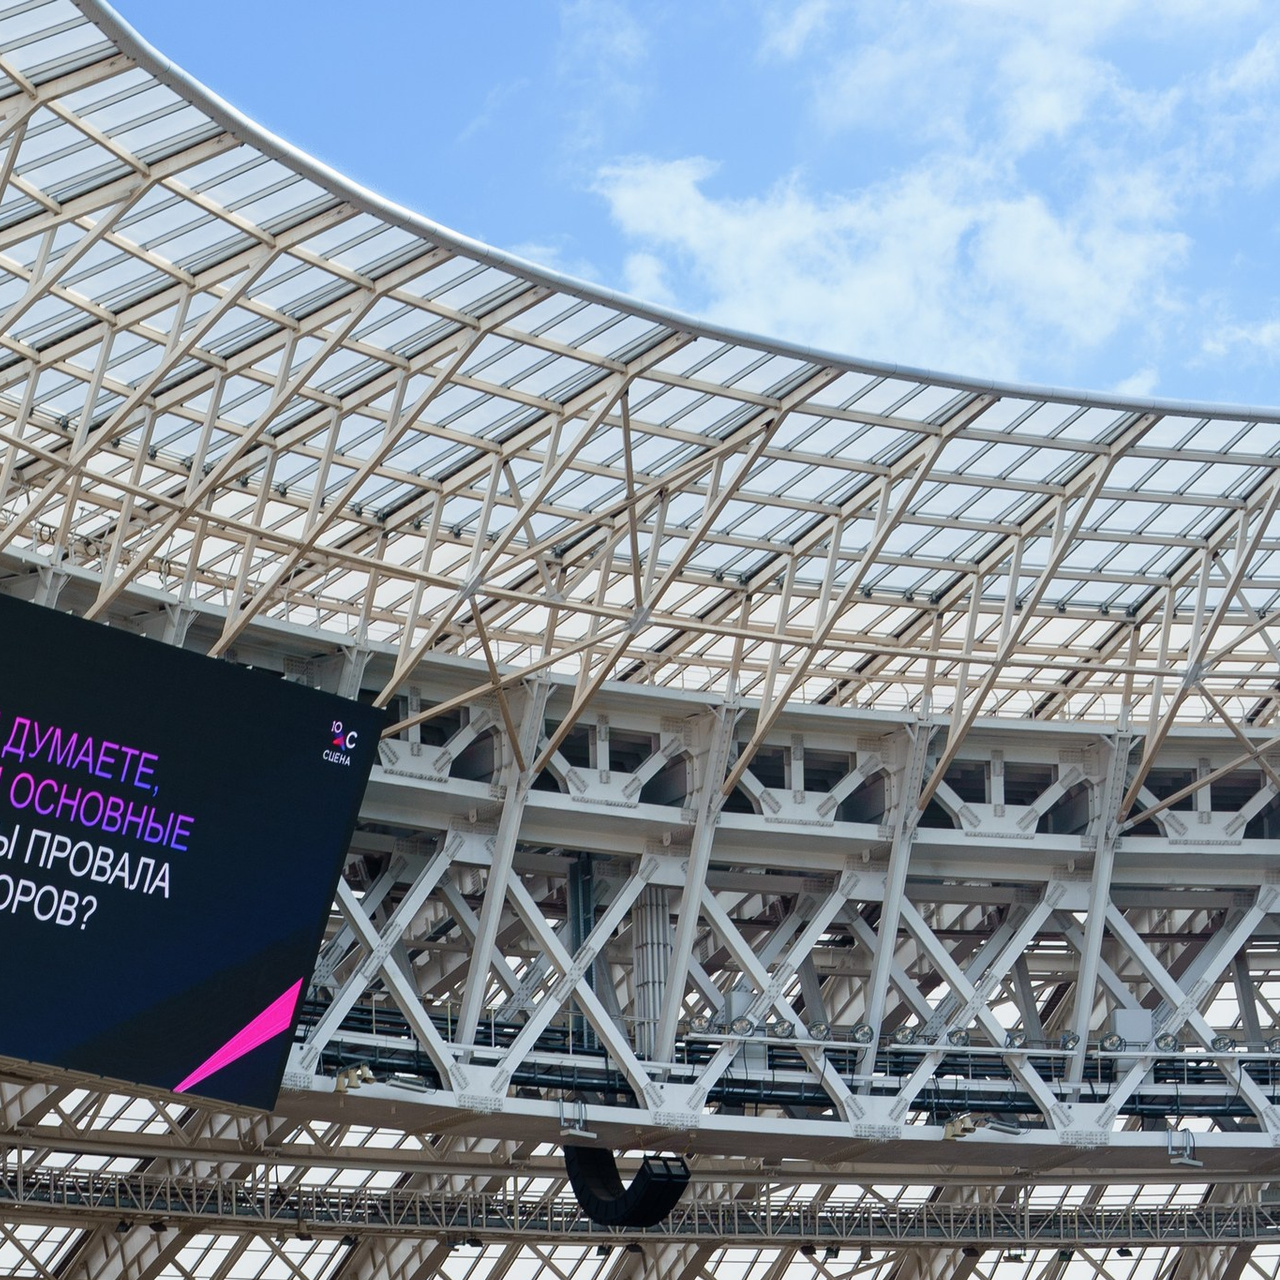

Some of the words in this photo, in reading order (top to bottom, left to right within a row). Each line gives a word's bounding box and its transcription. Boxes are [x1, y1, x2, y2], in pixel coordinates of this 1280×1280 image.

[1, 716, 159, 797] ДУМАЕТЕ,
[322, 749, 351, 767] СЦЕНА
[9, 772, 195, 852] ОСНОВНЫЕ
[23, 828, 170, 899] ПРОВАЛА
